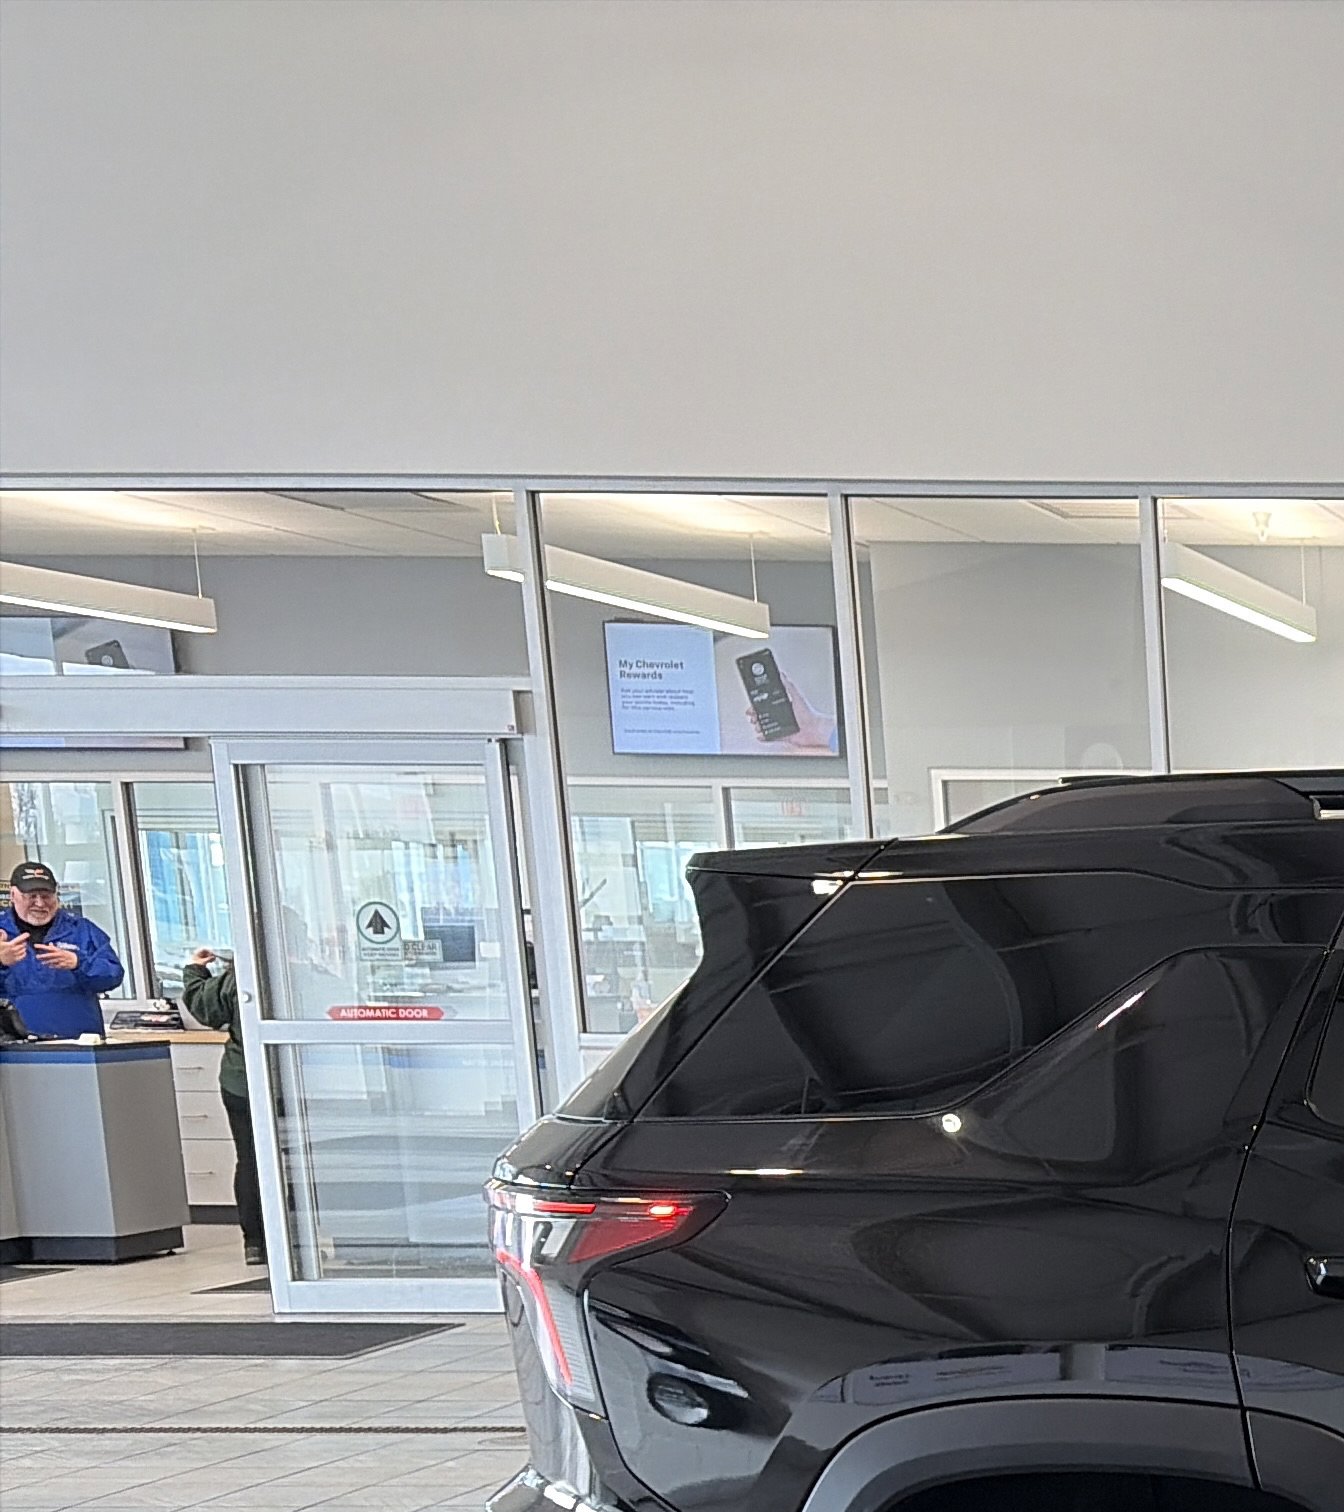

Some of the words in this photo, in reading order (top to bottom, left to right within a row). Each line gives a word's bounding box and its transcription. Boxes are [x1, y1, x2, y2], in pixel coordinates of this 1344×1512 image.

[618, 659, 634, 670] My
[635, 659, 684, 670] Chevrolet
[619, 670, 663, 680] Rewards
[340, 1008, 397, 1018] AUTOMATIC
[398, 1008, 429, 1018] DOOR
